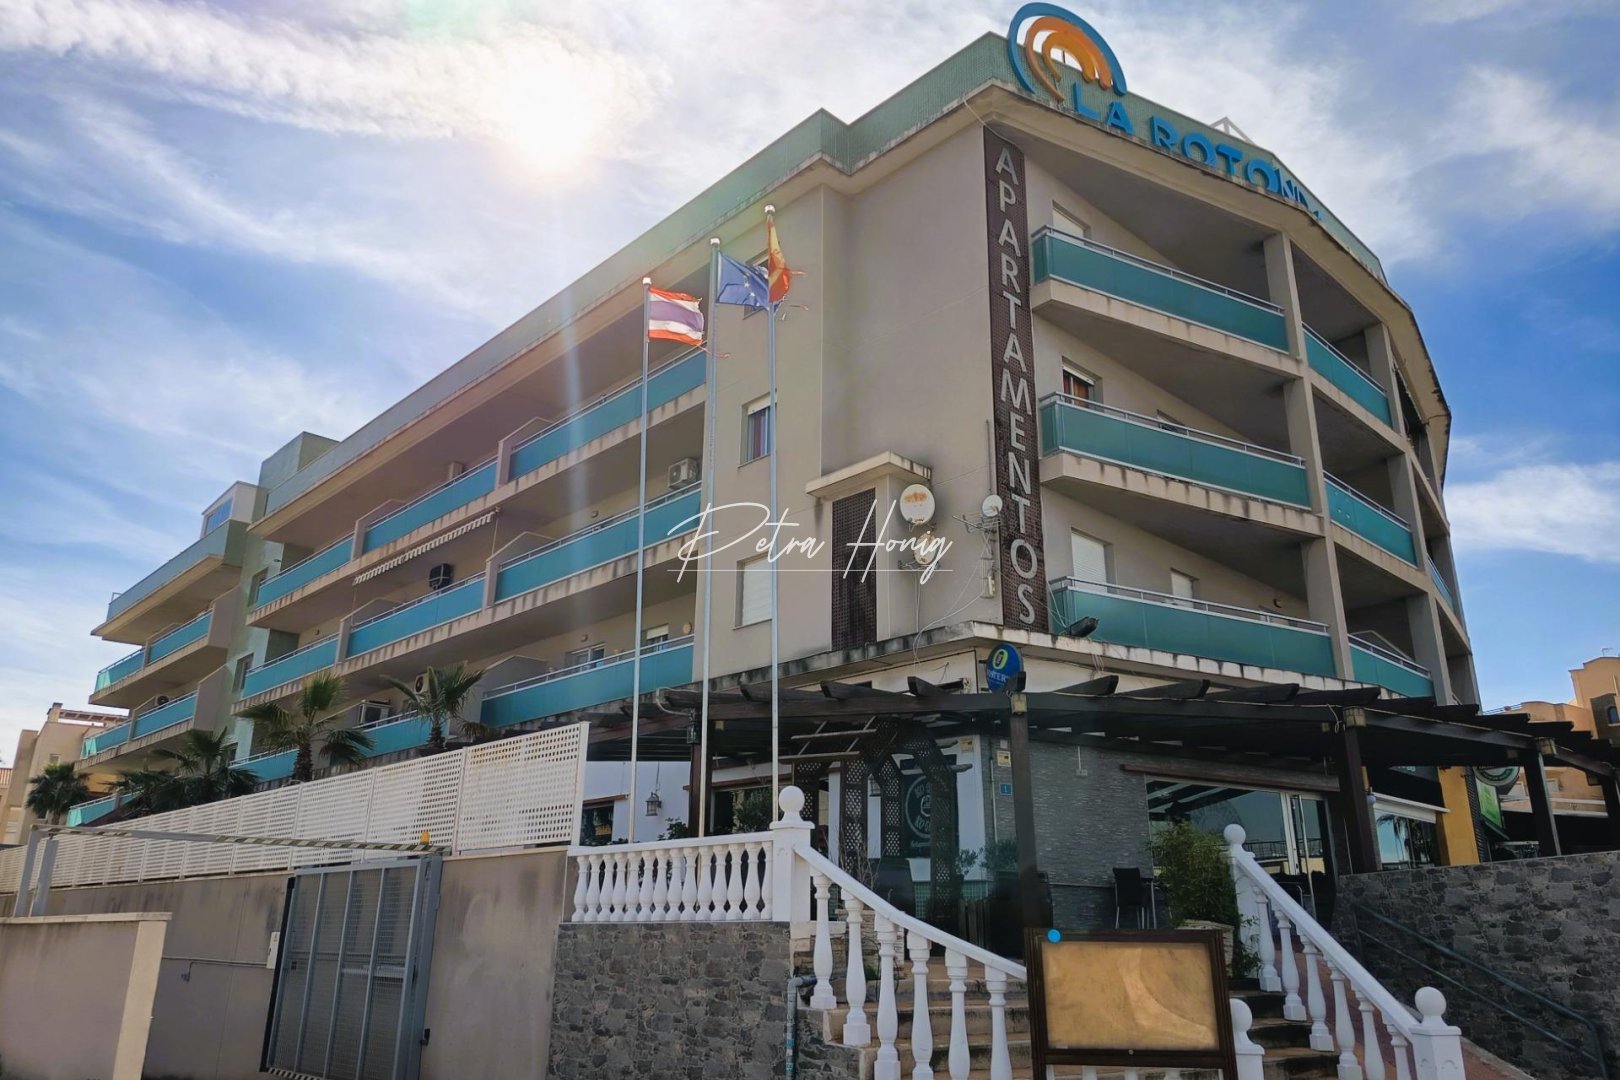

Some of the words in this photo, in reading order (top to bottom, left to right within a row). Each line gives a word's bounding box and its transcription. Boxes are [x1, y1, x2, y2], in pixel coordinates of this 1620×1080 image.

[1073, 81, 1134, 136] LA
[1151, 115, 1323, 220] ROTON
[995, 148, 1038, 624] APARTAMENTOS
